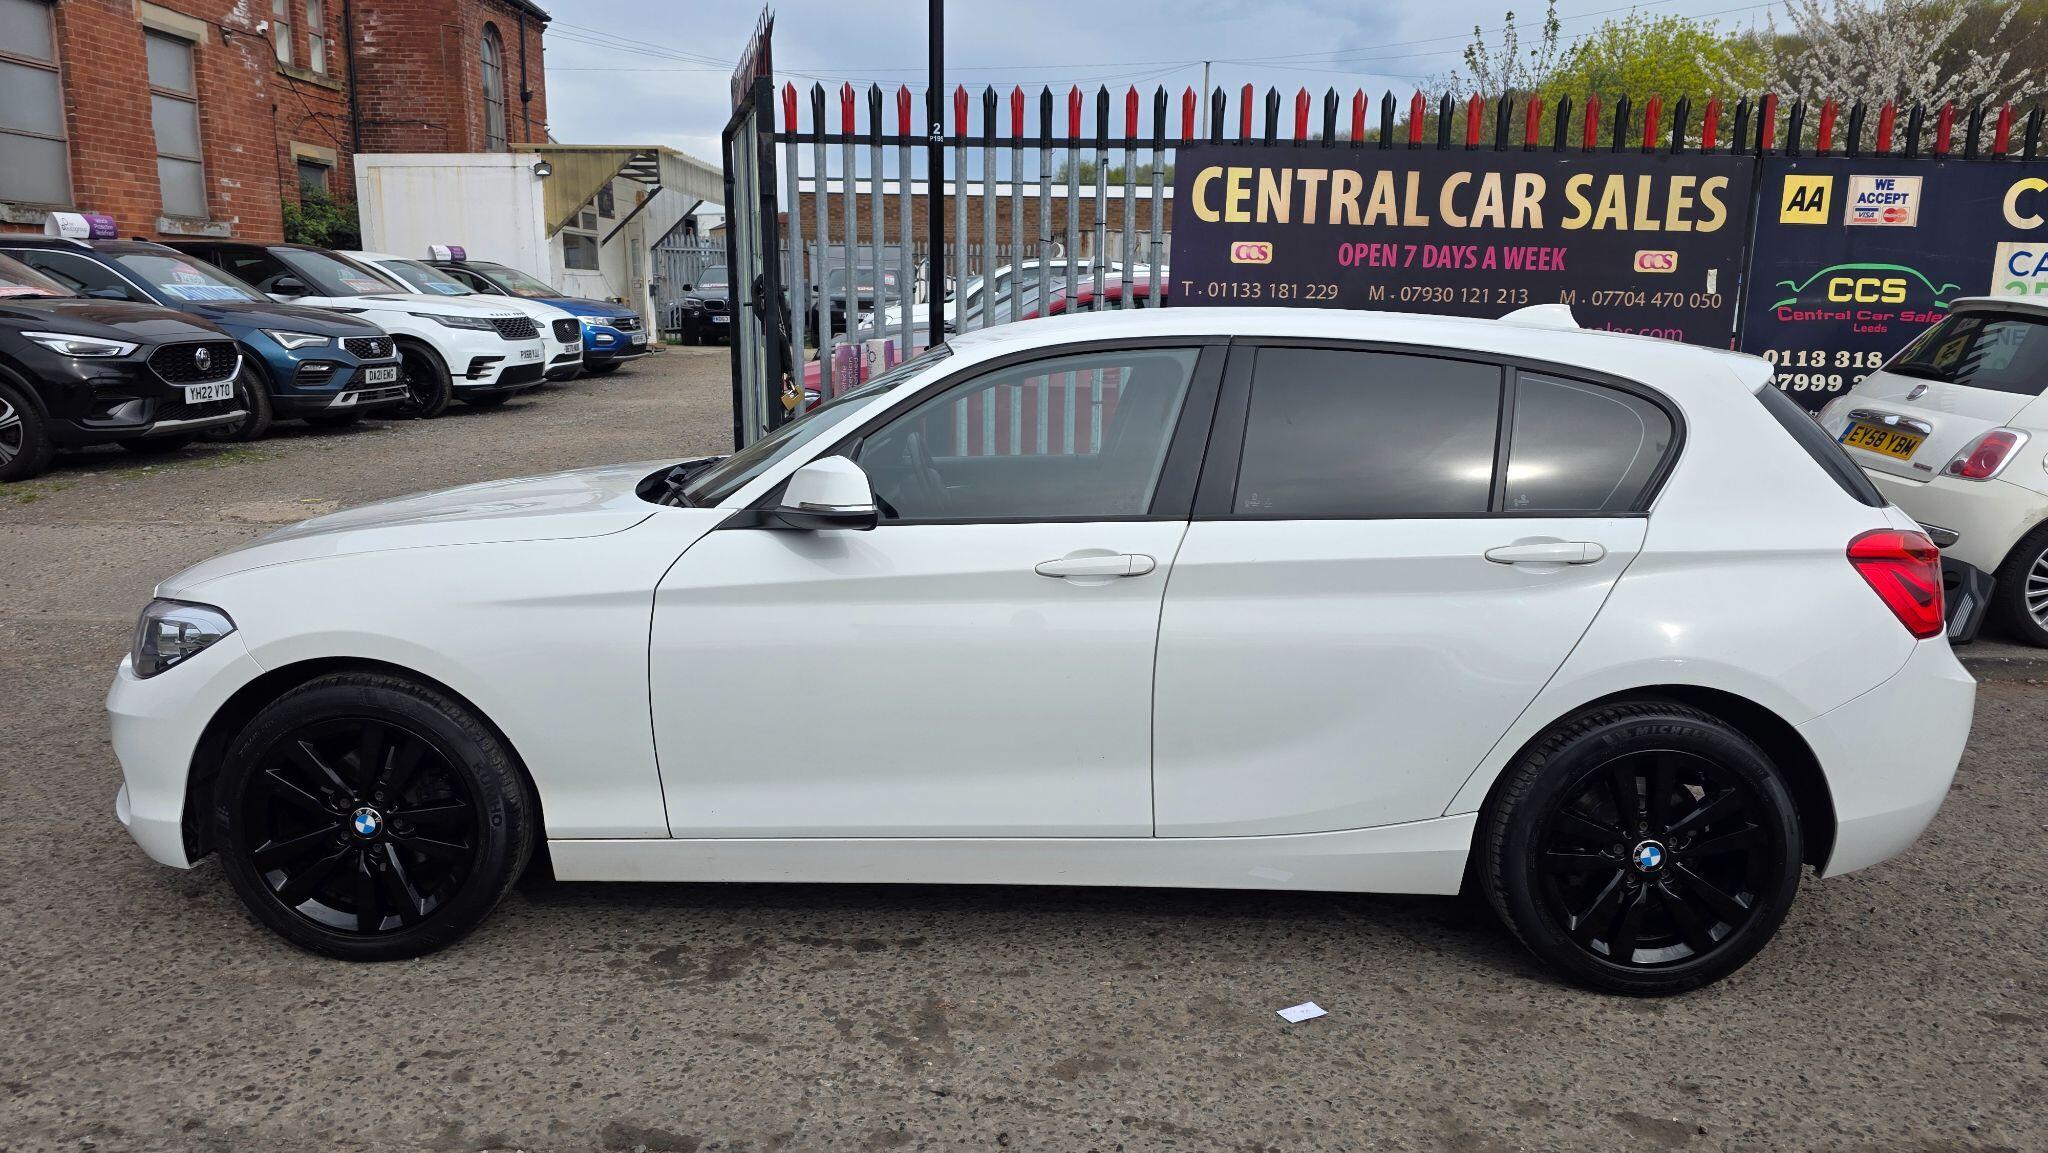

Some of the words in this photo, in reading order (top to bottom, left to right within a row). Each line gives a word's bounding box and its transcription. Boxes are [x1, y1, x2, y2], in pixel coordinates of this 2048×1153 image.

[933, 122, 941, 135] 2
[1874, 178, 1896, 191] WE
[1191, 165, 1430, 227] CENTRAL
[1439, 171, 1547, 229] CAR
[1560, 173, 1730, 233] SALES
[1786, 185, 1826, 212] AA
[1856, 192, 1910, 205] ACCEPT
[1235, 244, 1268, 261] CCS
[1338, 242, 1398, 268] OPEN
[1403, 244, 1418, 268] 7
[1422, 244, 1478, 269] DAYS
[1481, 245, 1497, 270] A
[1503, 246, 1568, 271] WEEK
[1638, 253, 1673, 270] CCS
[1207, 282, 1262, 299] 01133
[1269, 283, 1297, 299] 181
[1305, 284, 1339, 300] 229
[1400, 286, 1454, 302] 07930
[1460, 288, 1489, 304] 121
[1496, 288, 1529, 304] 213
[1828, 277, 1907, 303] CCS
[1591, 291, 1646, 307] 07704
[1650, 292, 1684, 308] 470
[1689, 293, 1722, 309] 050
[1777, 306, 1851, 322] Central
[1856, 310, 1895, 321] Car
[1899, 310, 1948, 323] Sale
[1853, 322, 1888, 333] Leeds
[1762, 349, 1826, 368] 0113
[1834, 350, 1883, 369] 318
[190, 385, 213, 401] YH22
[214, 383, 230, 398] VTO
[1848, 425, 1888, 448] EY58
[1885, 431, 1918, 456] YBM
